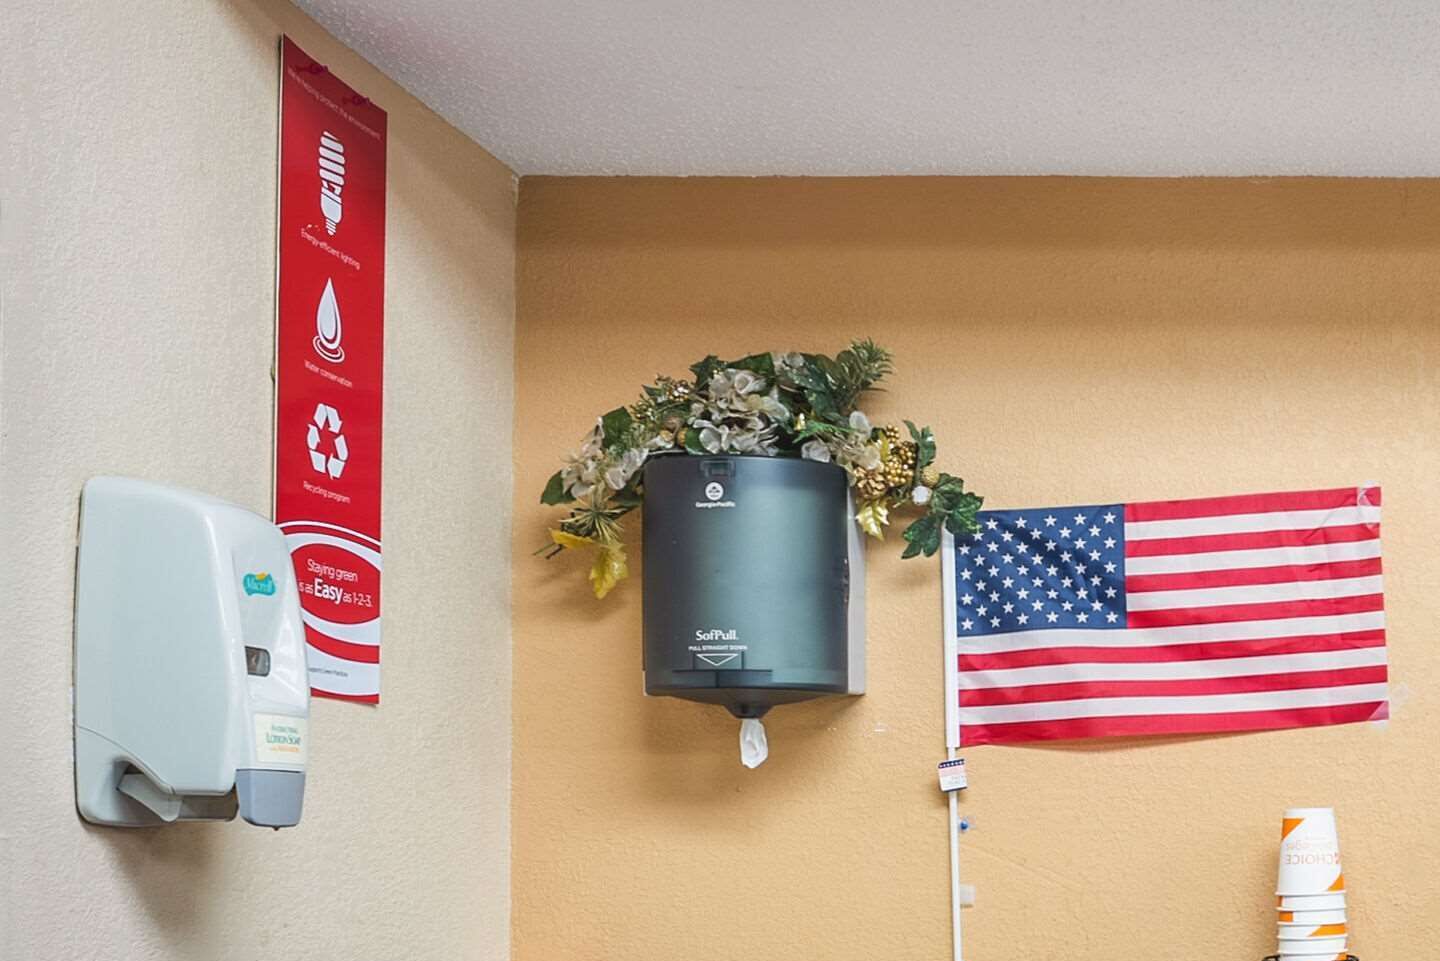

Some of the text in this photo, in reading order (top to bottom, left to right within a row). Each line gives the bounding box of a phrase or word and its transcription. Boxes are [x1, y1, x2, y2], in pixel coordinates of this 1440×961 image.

[307, 558, 358, 582] Staying green
[314, 577, 343, 605] Easy
[343, 592, 352, 604] as
